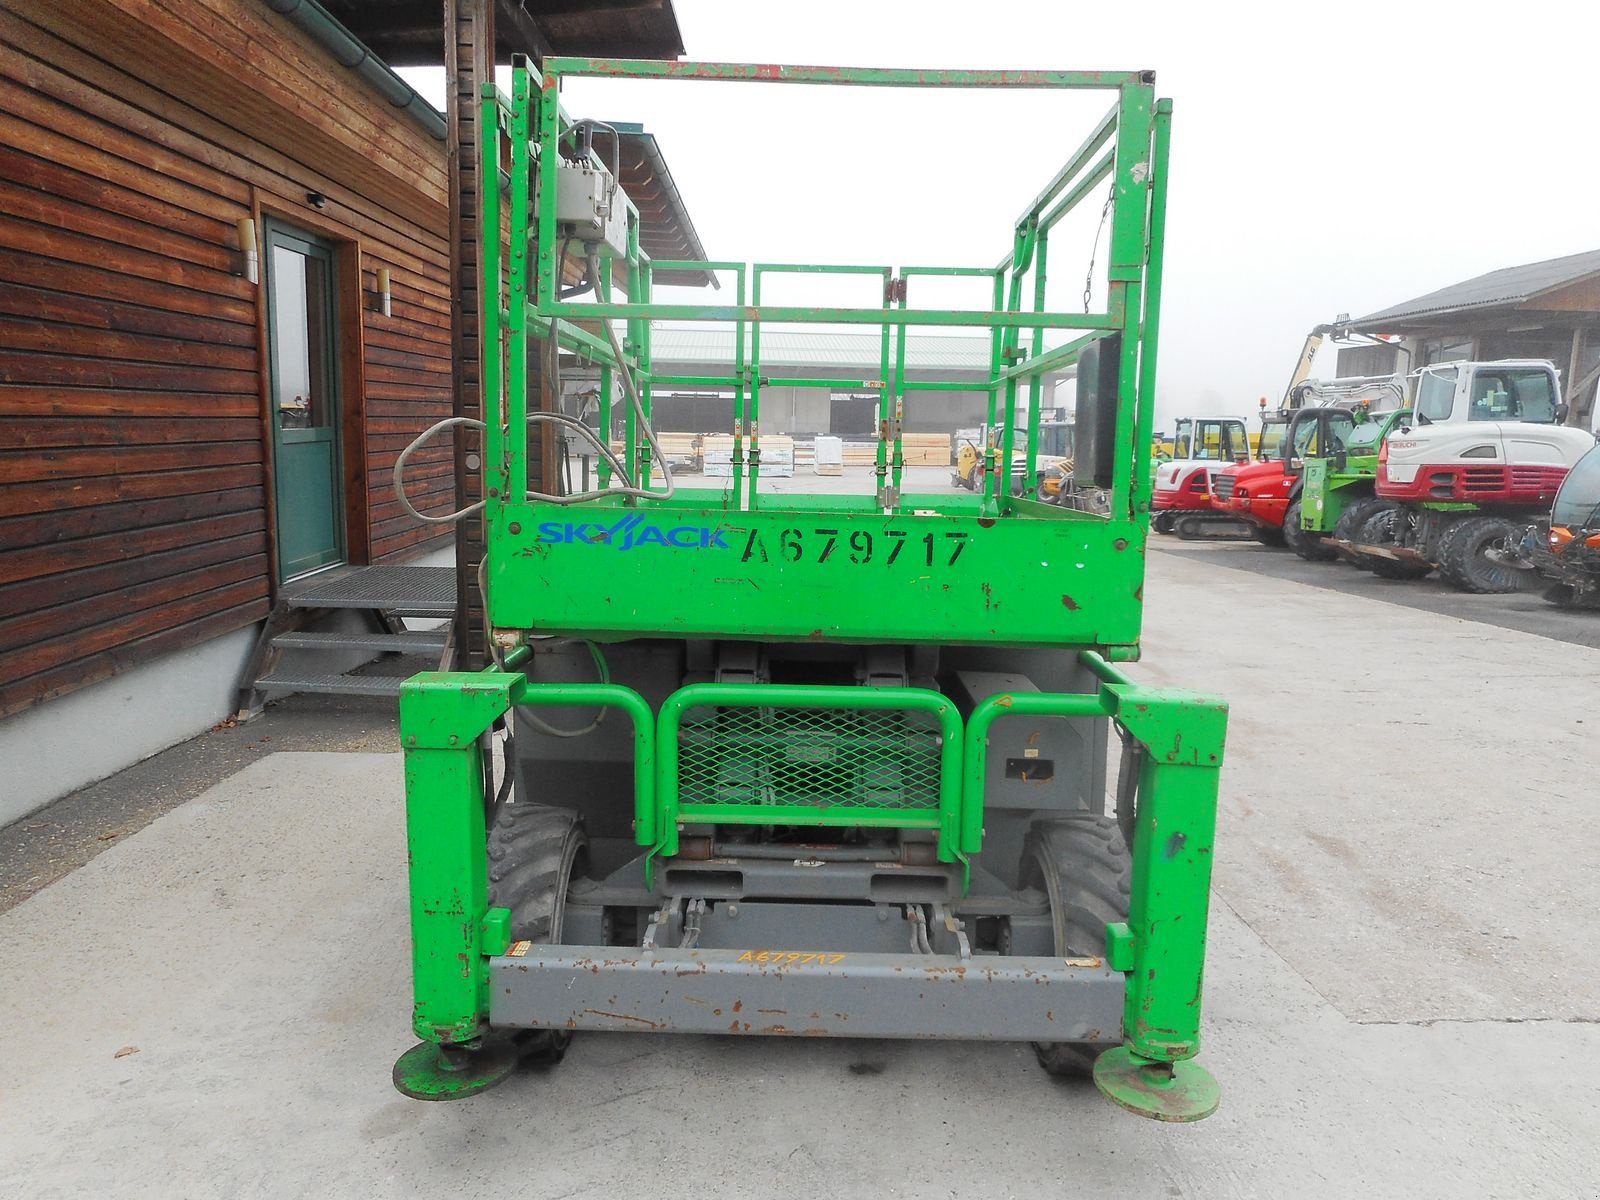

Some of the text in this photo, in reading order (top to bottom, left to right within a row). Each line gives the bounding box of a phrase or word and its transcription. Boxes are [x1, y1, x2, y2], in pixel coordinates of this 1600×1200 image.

[538, 512, 729, 551] SKYJACK
[741, 528, 968, 567] A679717
[737, 950, 846, 965] A679717
